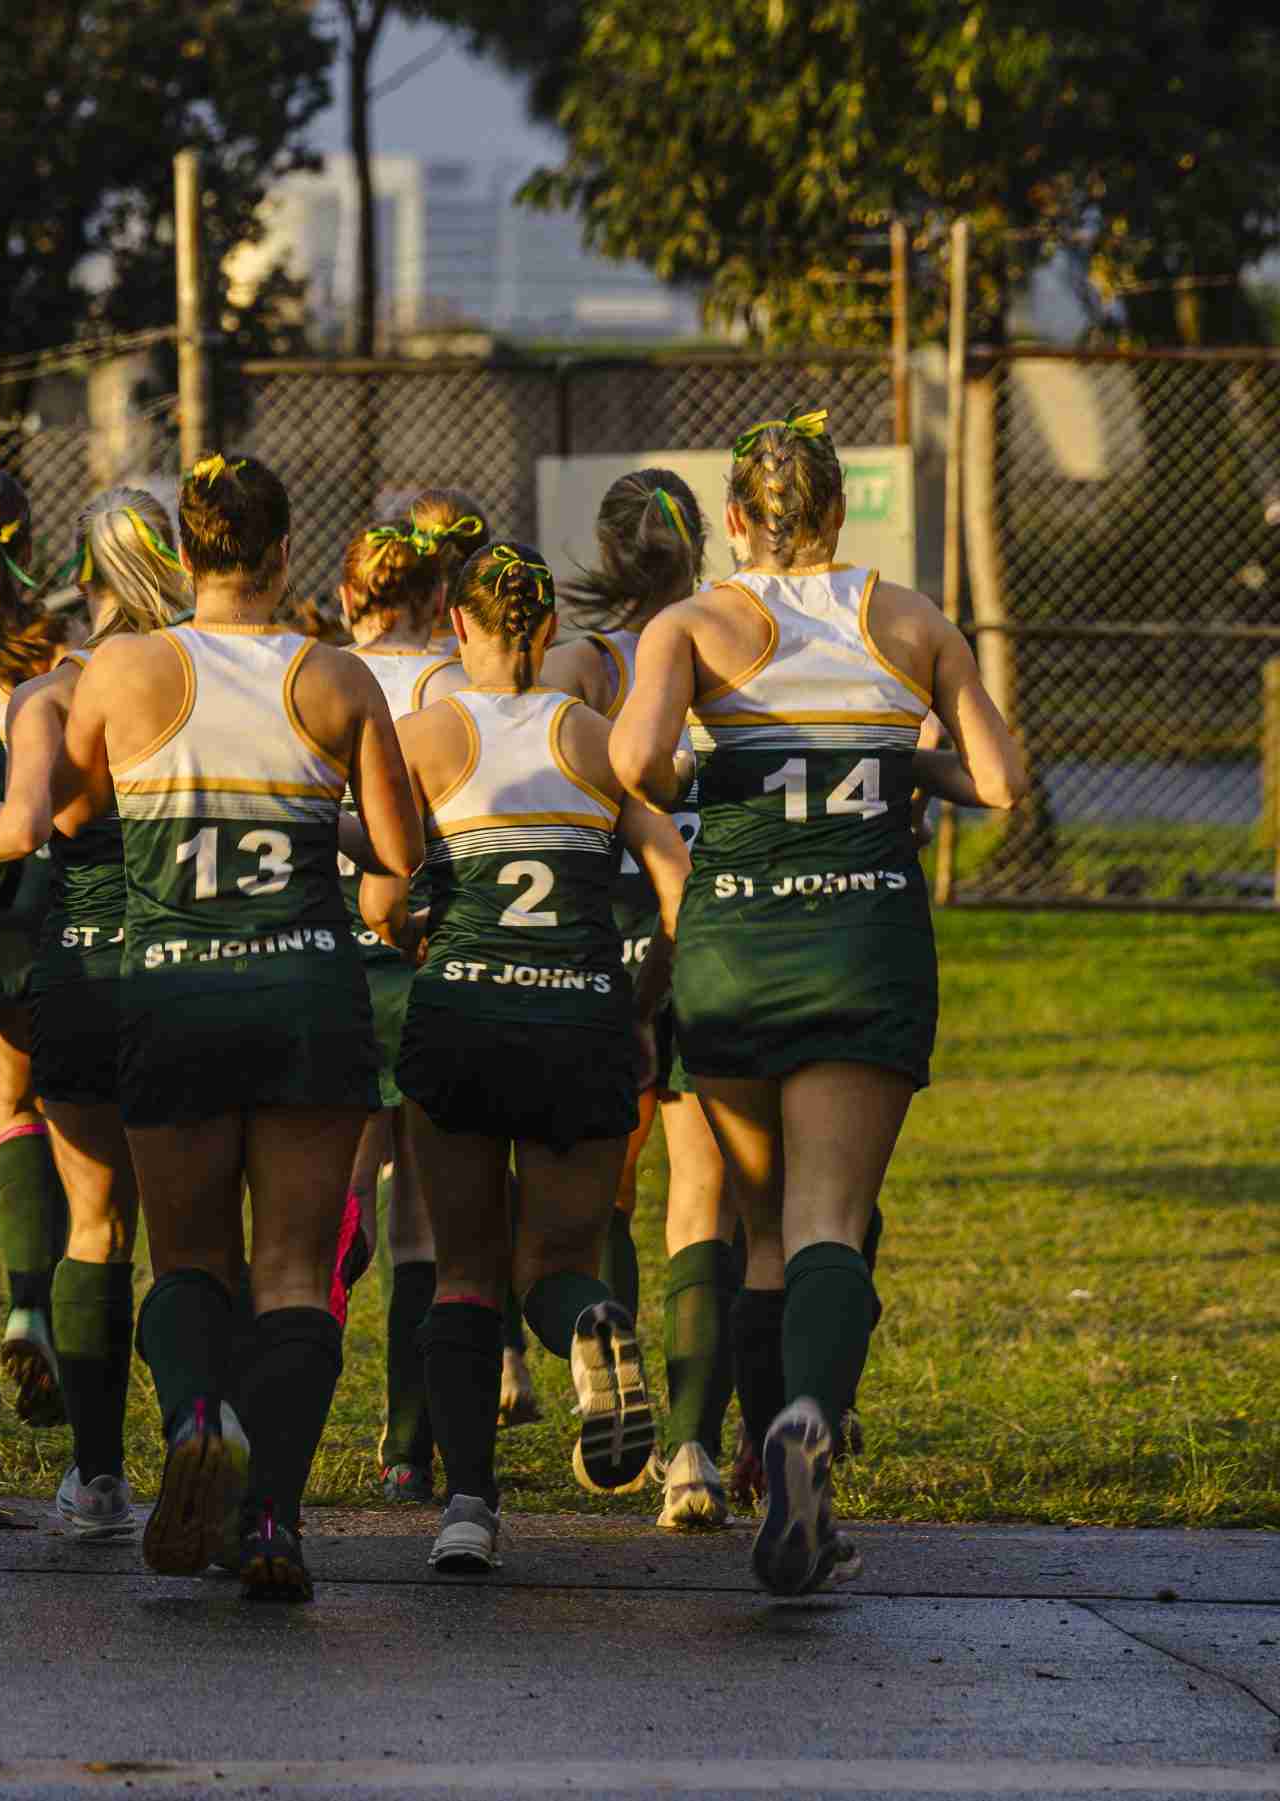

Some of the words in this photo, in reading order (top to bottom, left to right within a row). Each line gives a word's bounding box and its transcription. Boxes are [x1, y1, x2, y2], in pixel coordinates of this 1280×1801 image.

[763, 758, 888, 823] 14
[176, 827, 294, 900] 13
[497, 860, 558, 926] 2
[715, 873, 753, 898] ST
[61, 926, 99, 947] ST
[144, 940, 187, 969] ST
[443, 961, 487, 982] ST
[492, 964, 612, 993] JOHN'S
